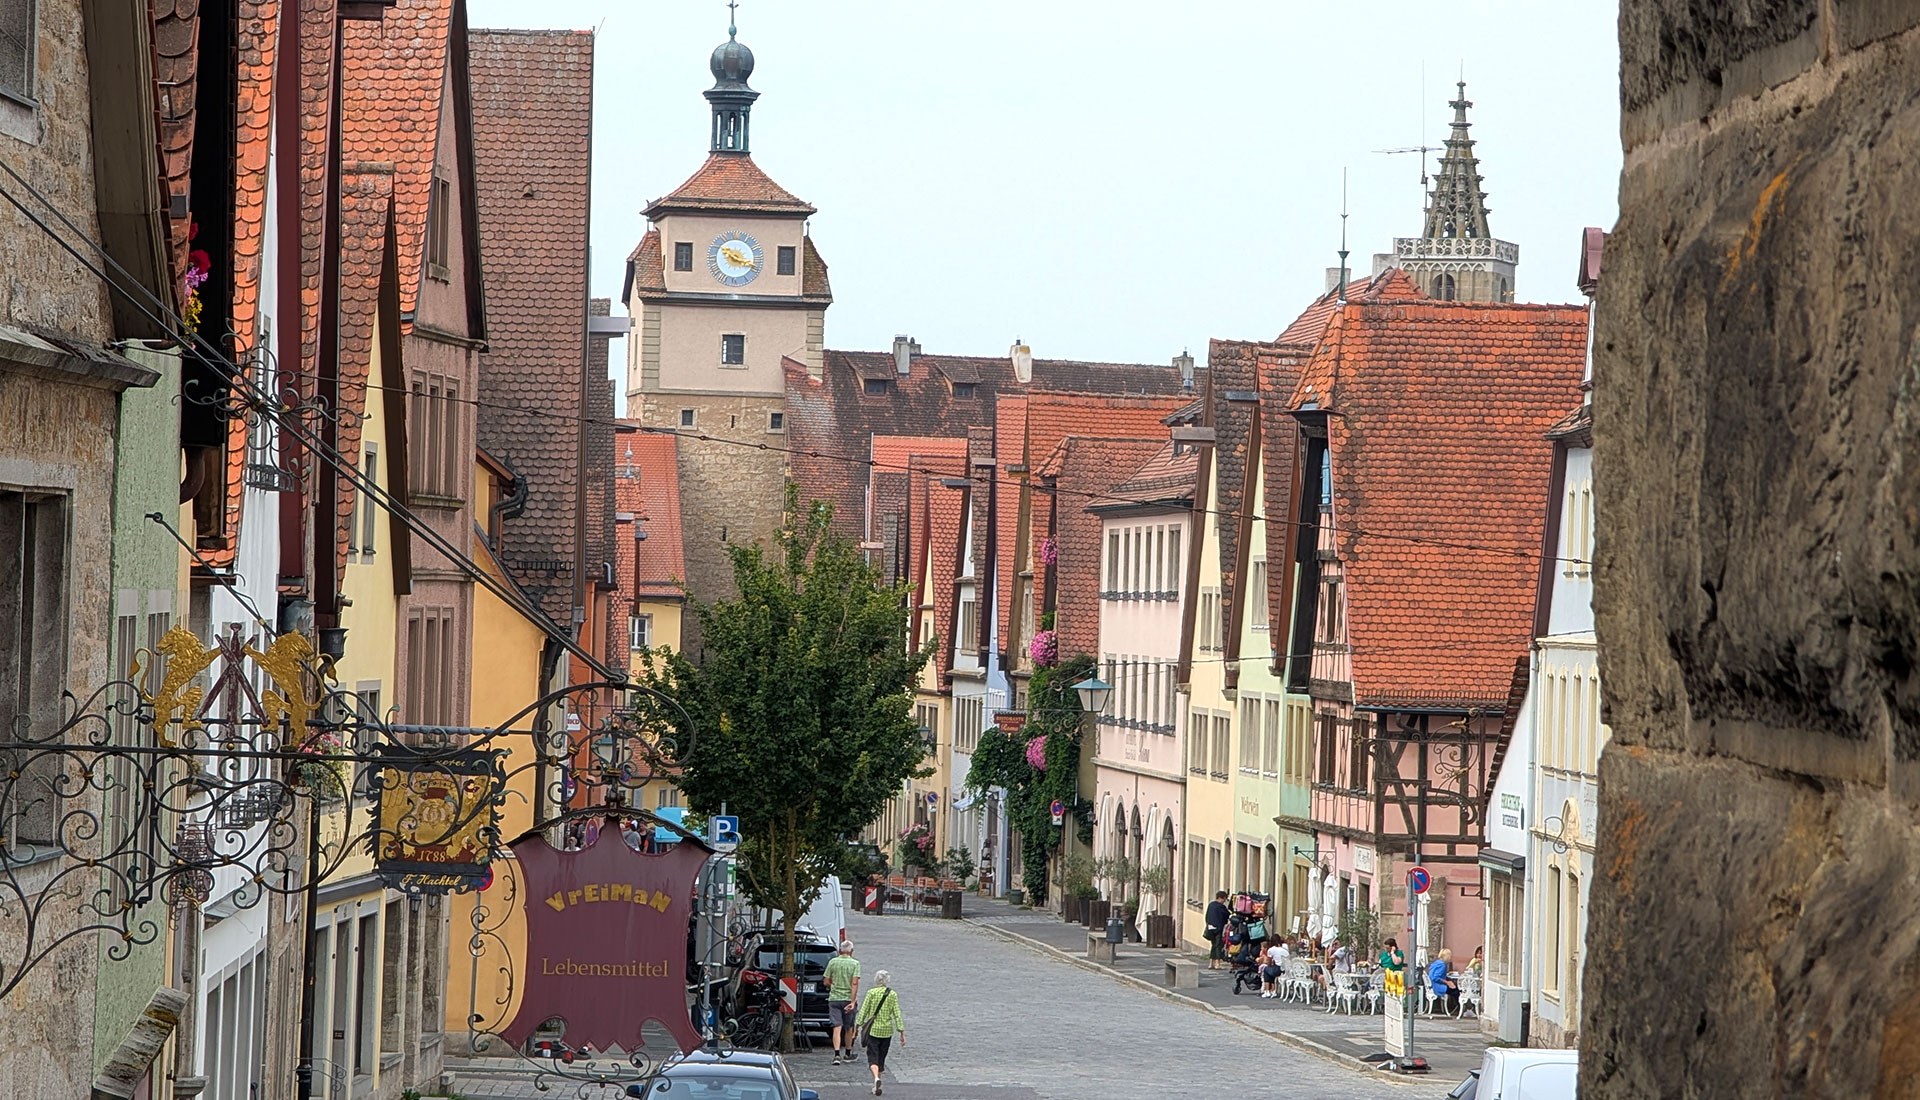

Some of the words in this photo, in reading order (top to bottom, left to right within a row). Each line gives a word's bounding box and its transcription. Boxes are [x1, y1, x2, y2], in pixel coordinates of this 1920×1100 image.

[715, 819, 731, 841] P
[417, 850, 446, 862] 1788
[542, 957, 669, 977] Lebensmittel
